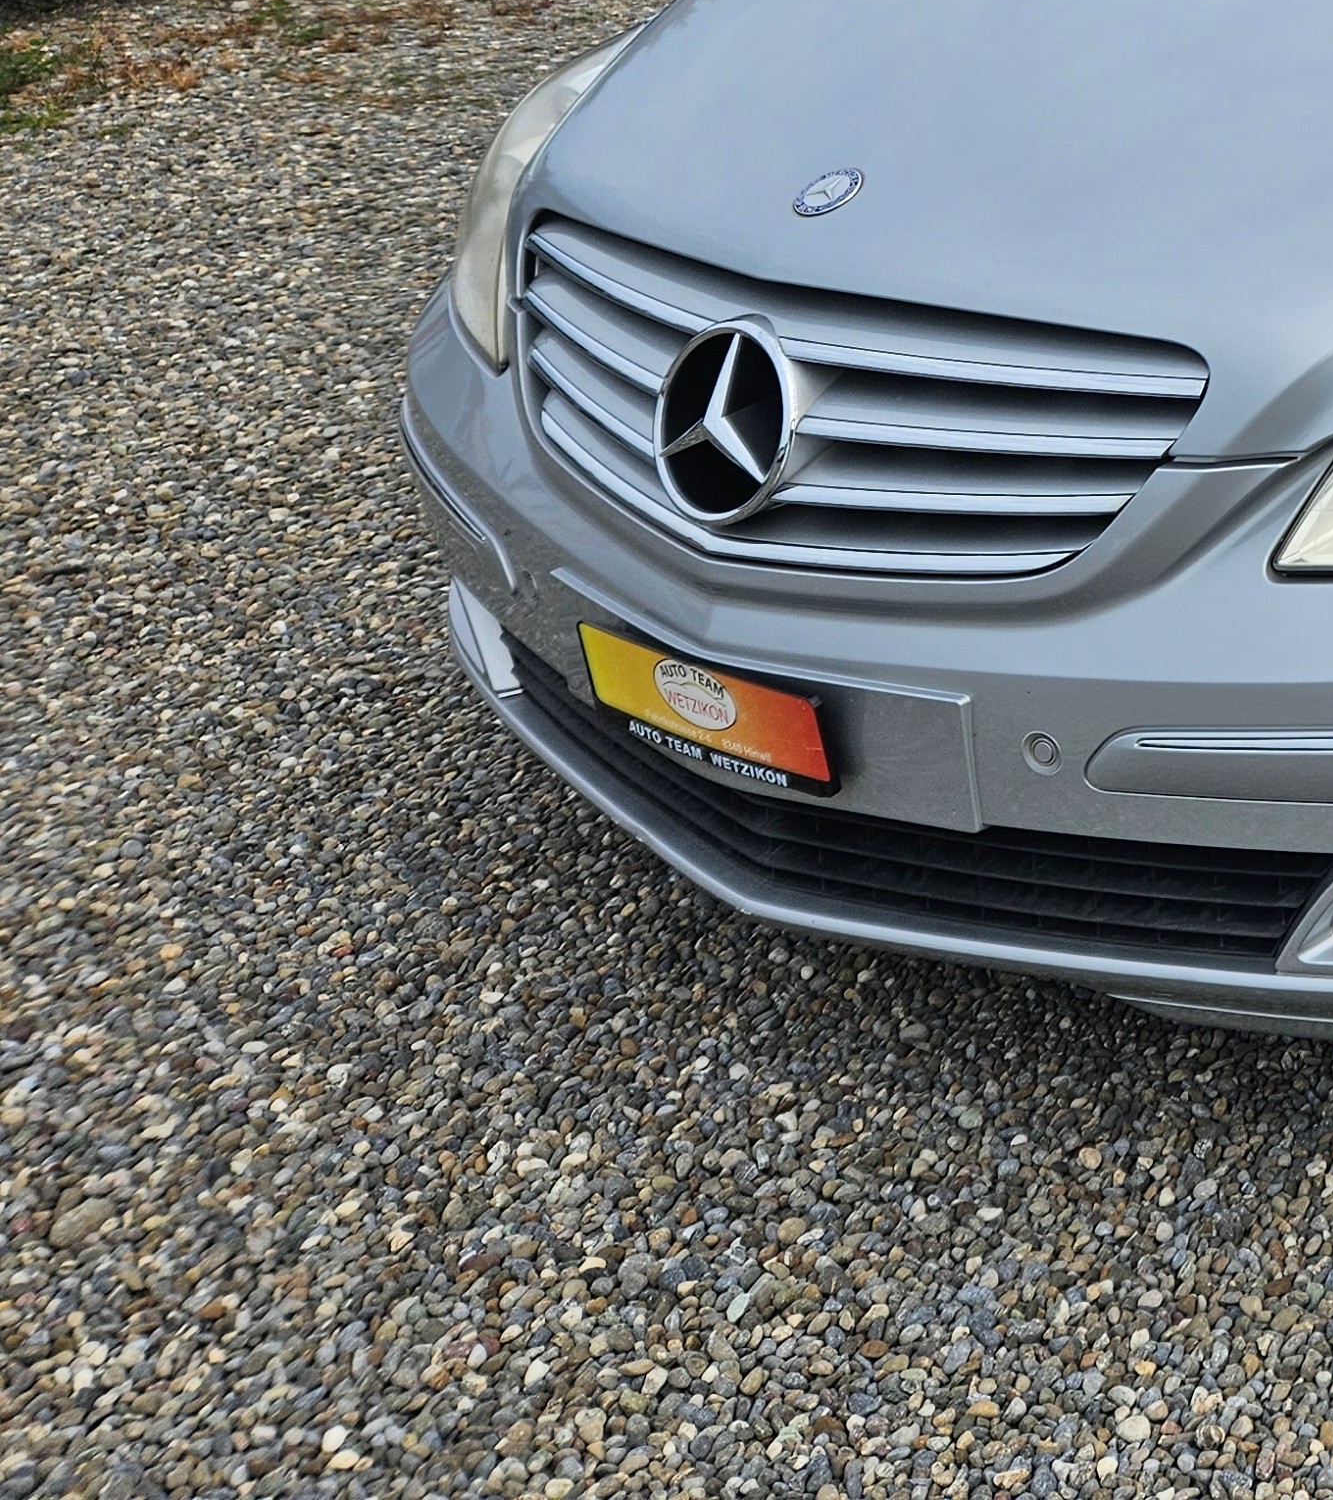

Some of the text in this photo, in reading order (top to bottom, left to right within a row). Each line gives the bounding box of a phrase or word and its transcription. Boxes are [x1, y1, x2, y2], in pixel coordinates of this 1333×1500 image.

[659, 664, 725, 699] AUTO TEAM
[664, 688, 729, 725] WETZIKON
[628, 719, 662, 744] AUTO
[665, 735, 703, 761] TEAM
[709, 752, 789, 788] WETZIKON
